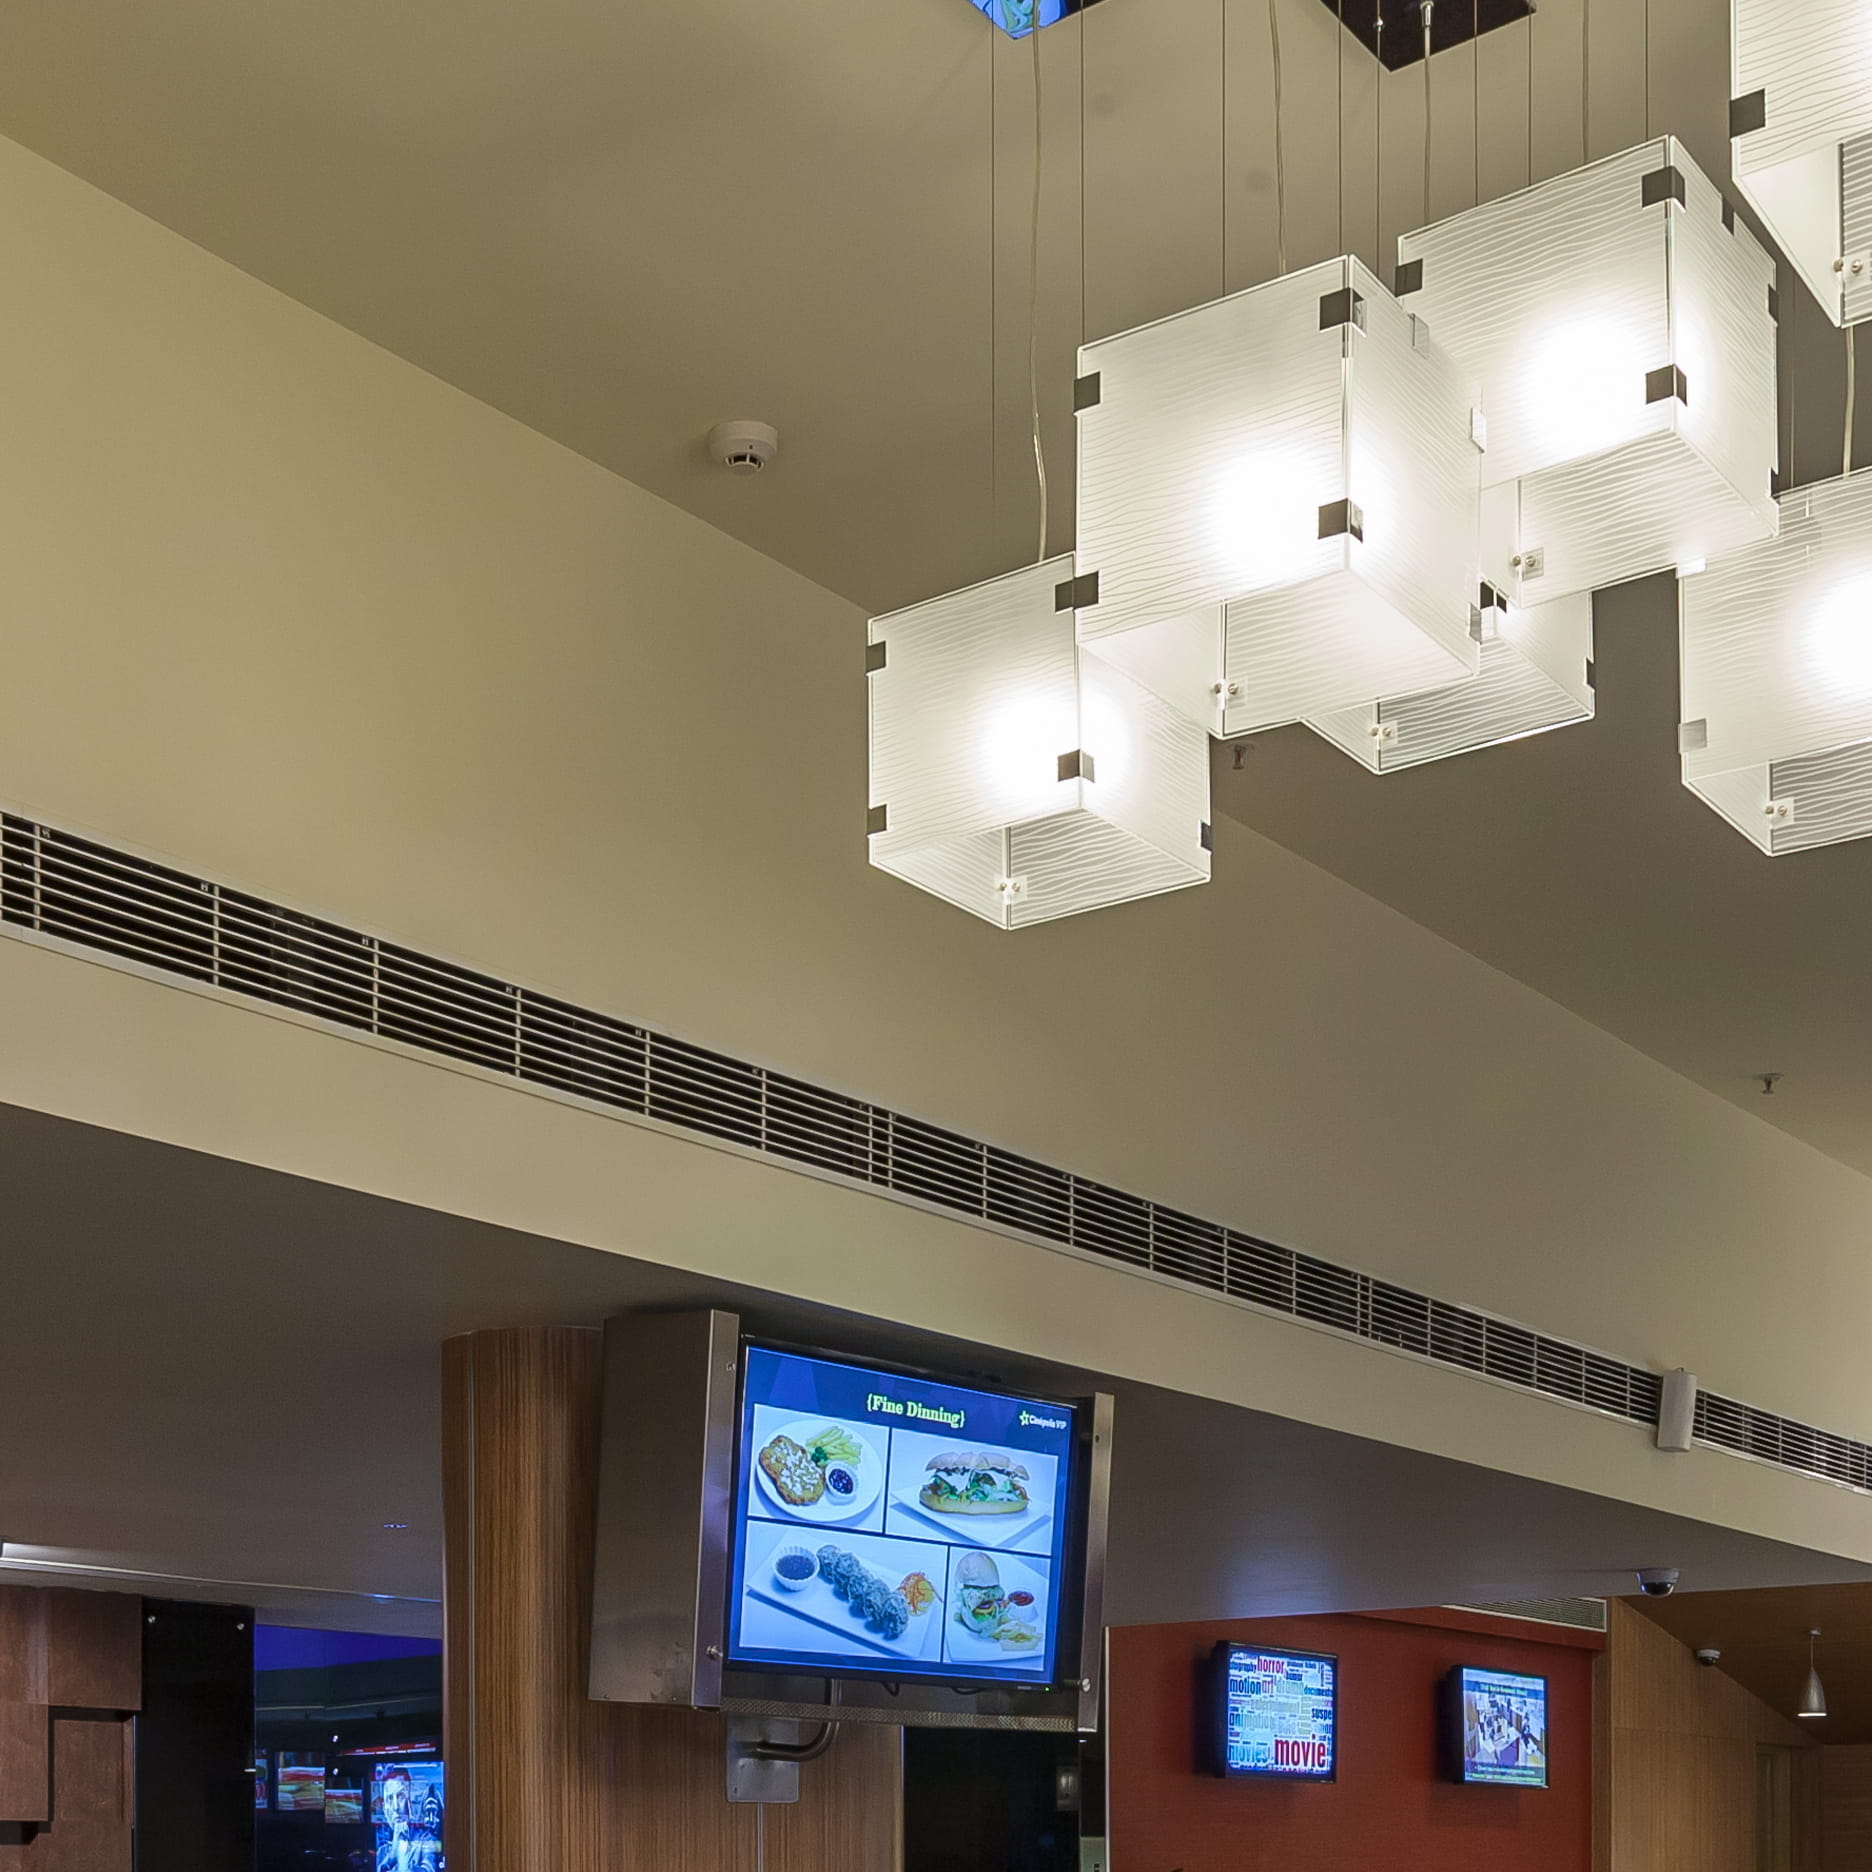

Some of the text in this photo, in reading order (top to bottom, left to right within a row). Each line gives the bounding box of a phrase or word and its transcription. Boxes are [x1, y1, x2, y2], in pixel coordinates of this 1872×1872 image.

[1257, 1655, 1284, 1674] horror
[1229, 1676, 1262, 1695] motion
[1262, 1677, 1274, 1694] art
[1274, 1734, 1326, 1768] movie
